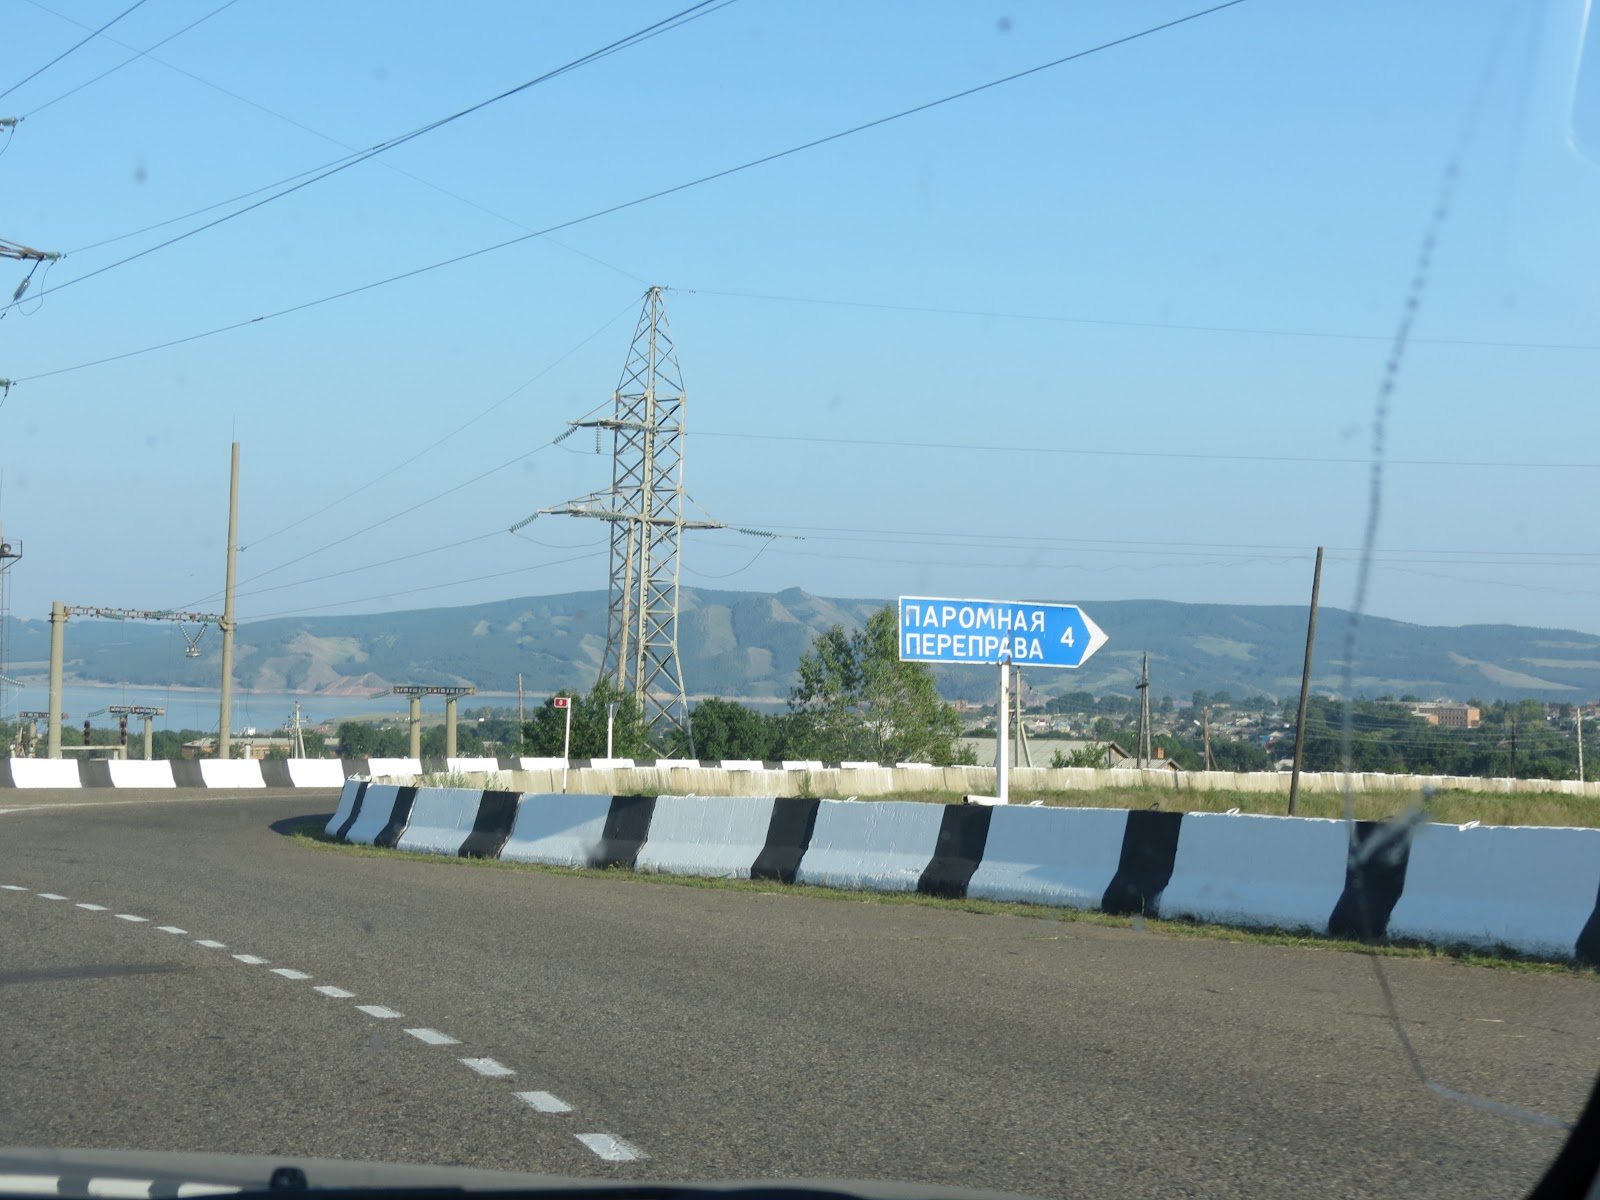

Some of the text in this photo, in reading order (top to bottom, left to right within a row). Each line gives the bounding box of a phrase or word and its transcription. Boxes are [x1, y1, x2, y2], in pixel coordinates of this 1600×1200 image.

[905, 605, 1045, 632] ПАРОМНАЯ
[906, 633, 1044, 659] ПЕРЕПРАВА
[1060, 626, 1074, 647] 4
